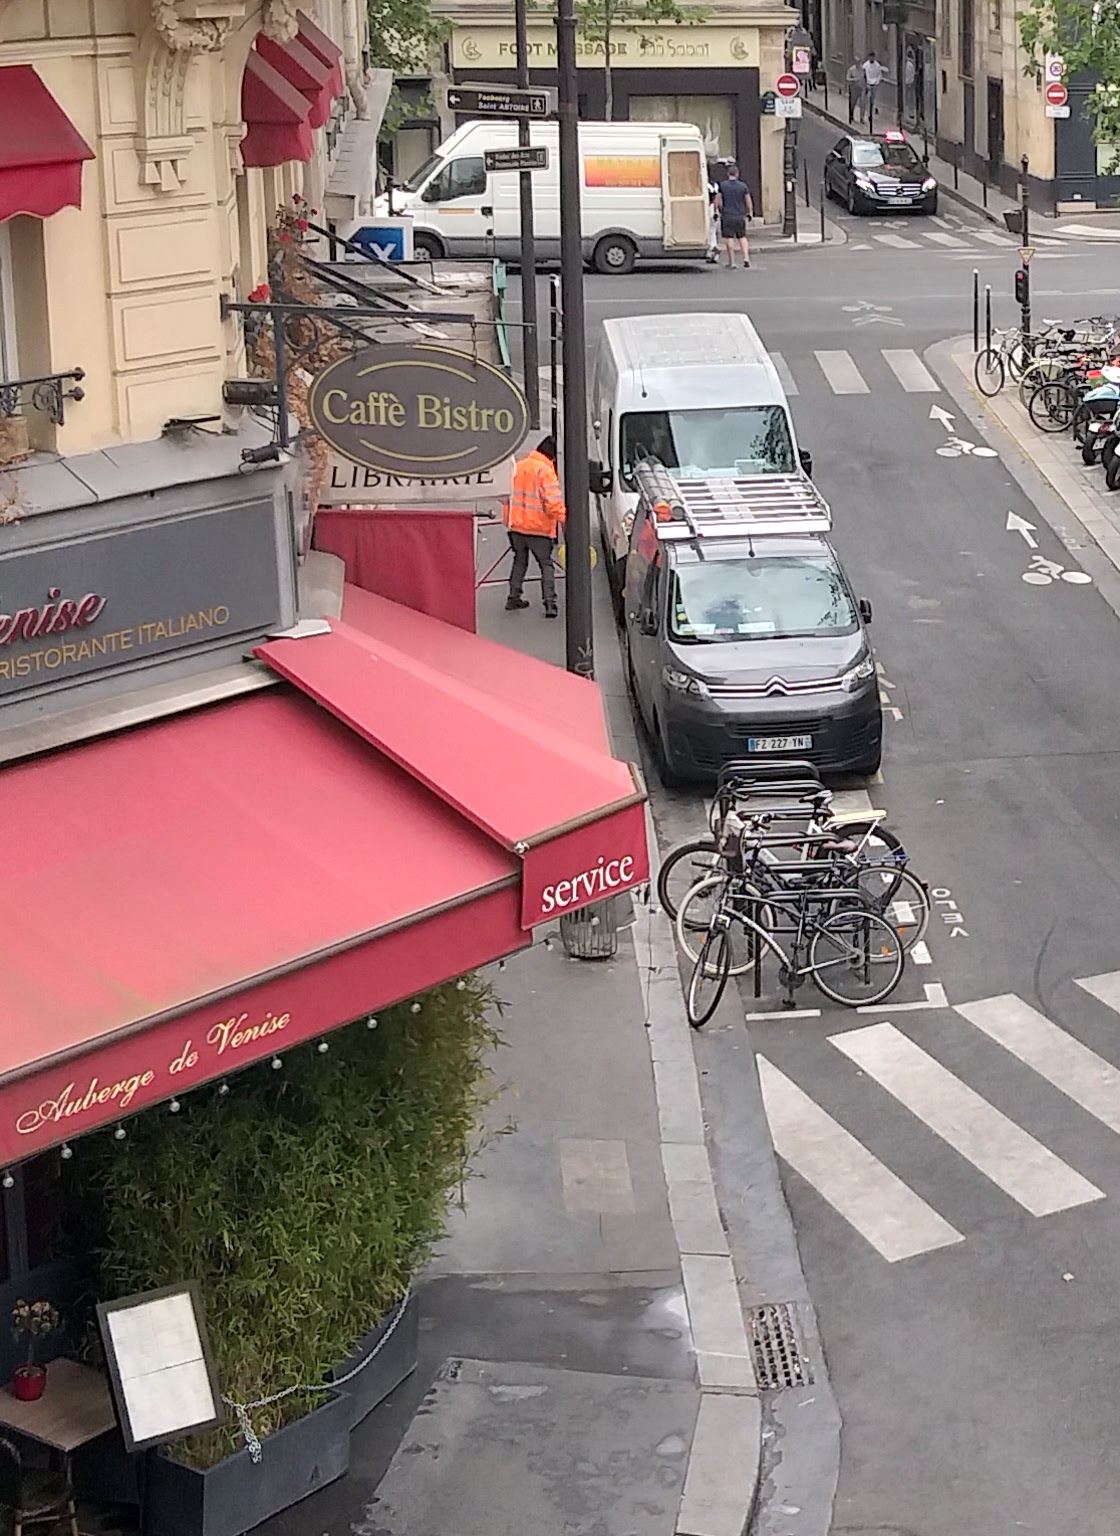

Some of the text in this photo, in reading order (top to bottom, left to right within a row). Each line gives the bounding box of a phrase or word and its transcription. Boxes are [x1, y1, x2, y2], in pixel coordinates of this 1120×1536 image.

[547, 42, 628, 56] MSSAGE
[322, 389, 514, 433] Caffè Bistro
[0, 605, 230, 680] RISTORANTE ITALIANO
[541, 855, 635, 913] service
[15, 1012, 291, 1135] Auberge de Venise
